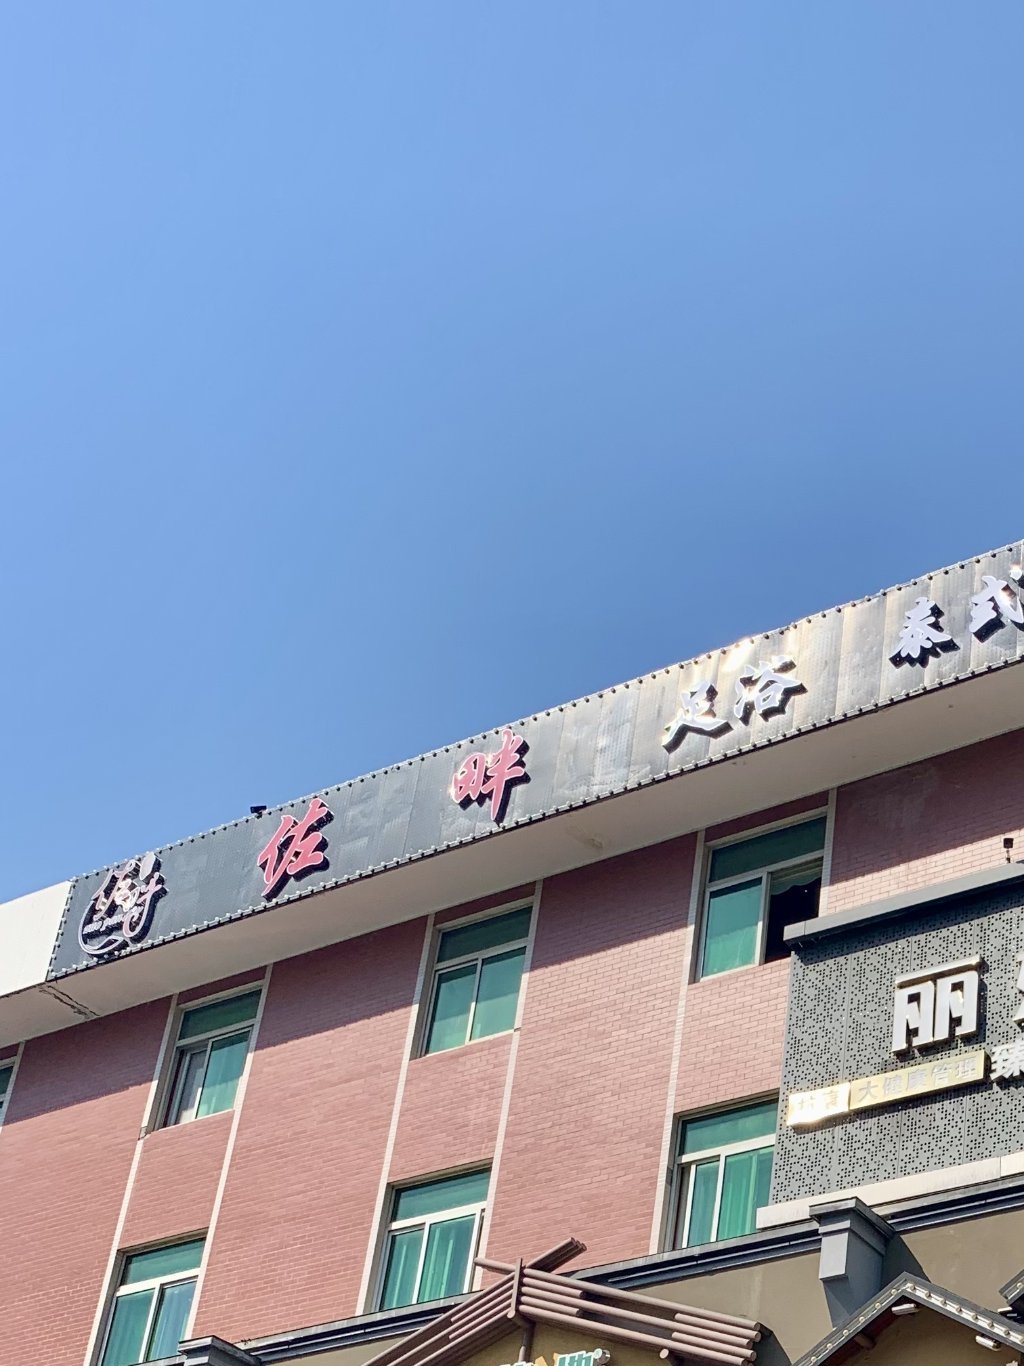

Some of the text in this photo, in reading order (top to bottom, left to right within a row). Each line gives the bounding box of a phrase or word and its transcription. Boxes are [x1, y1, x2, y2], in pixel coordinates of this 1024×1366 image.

[857, 1055, 980, 1104] 大健康管理
